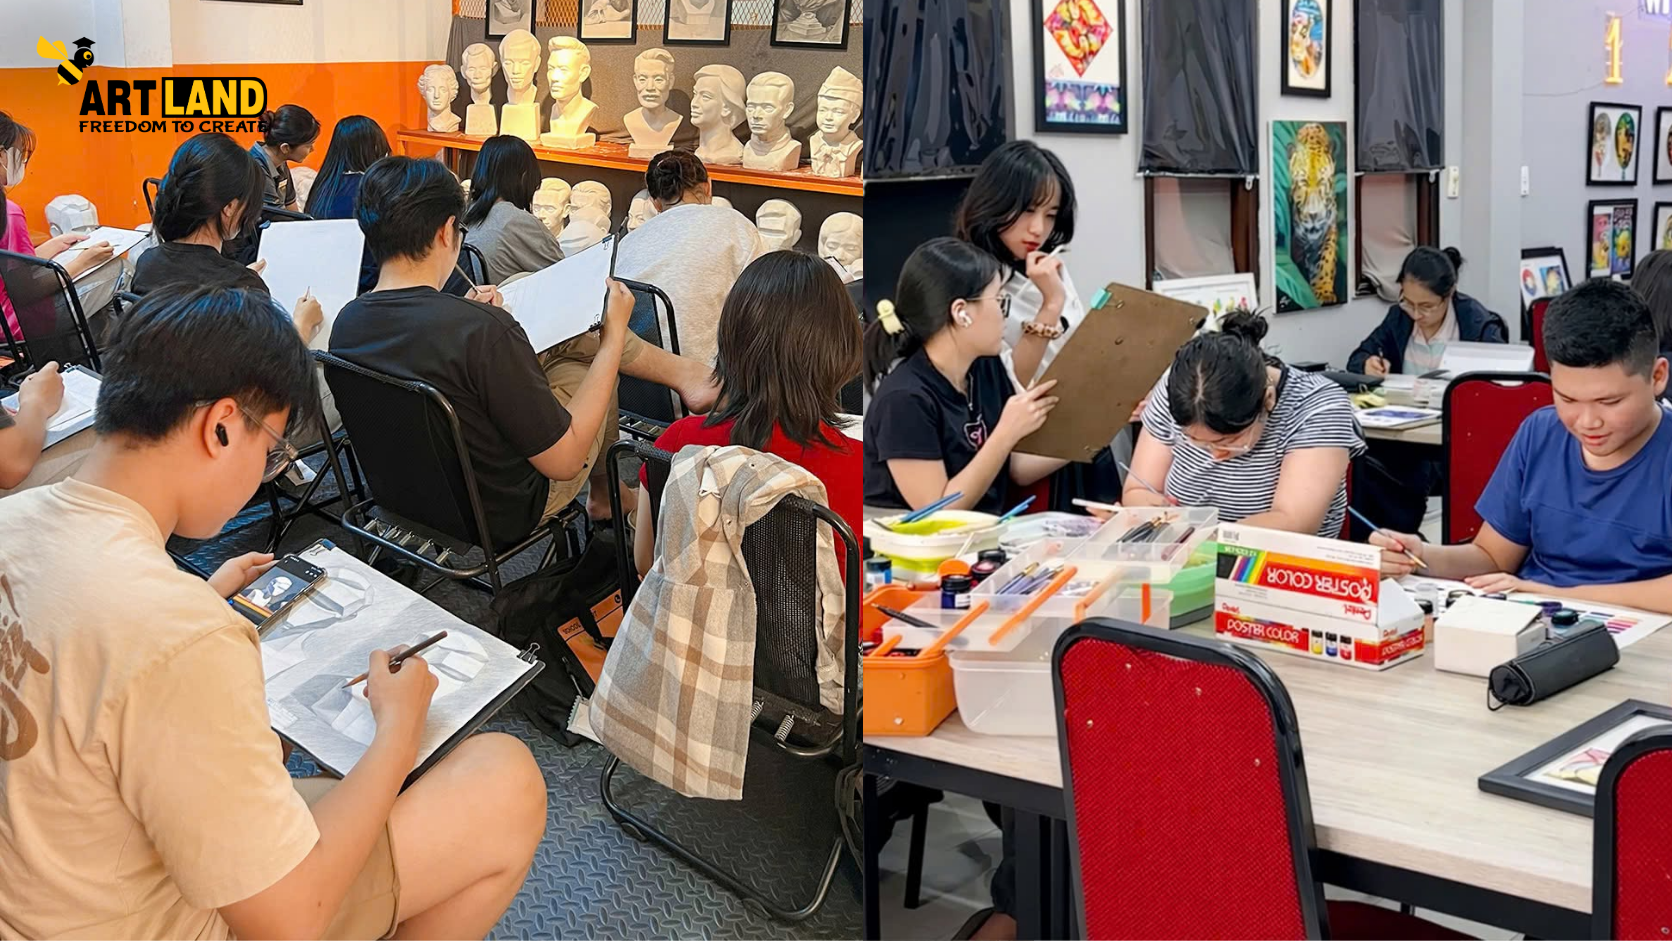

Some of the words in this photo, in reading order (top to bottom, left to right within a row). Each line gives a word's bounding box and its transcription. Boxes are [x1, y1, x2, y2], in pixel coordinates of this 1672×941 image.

[1267, 567, 1312, 589] COLOR
[1315, 574, 1372, 602] POSTER
[1343, 603, 1371, 620] Pentel
[1227, 619, 1266, 637] POSTER
[1266, 626, 1300, 643] COLOR
